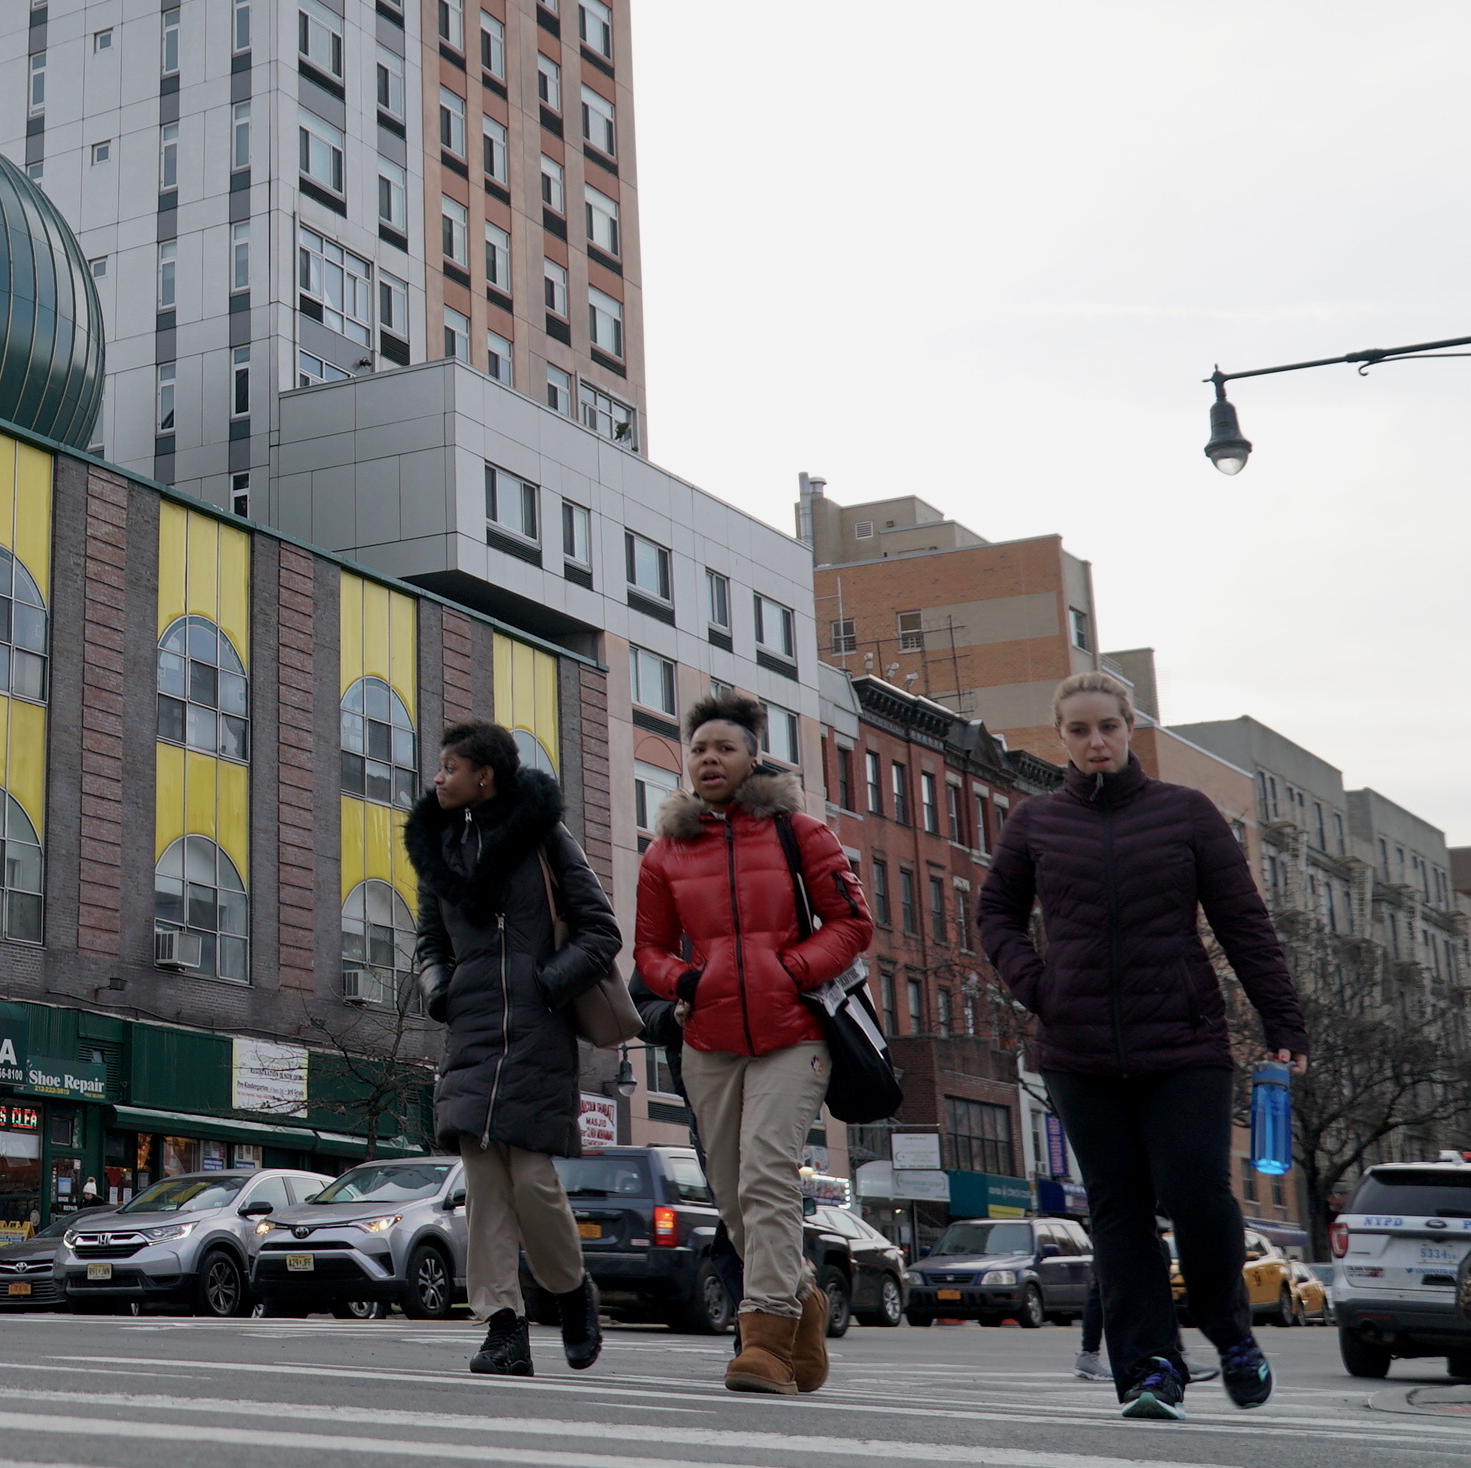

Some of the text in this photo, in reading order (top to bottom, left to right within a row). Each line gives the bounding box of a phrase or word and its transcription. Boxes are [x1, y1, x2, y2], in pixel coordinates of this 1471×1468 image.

[28, 1070, 104, 1094] Shoe Repair
[12, 1107, 38, 1129] CLEA
[1364, 1216, 1404, 1226] NYPD
[1420, 1248, 1448, 1258] 5334
